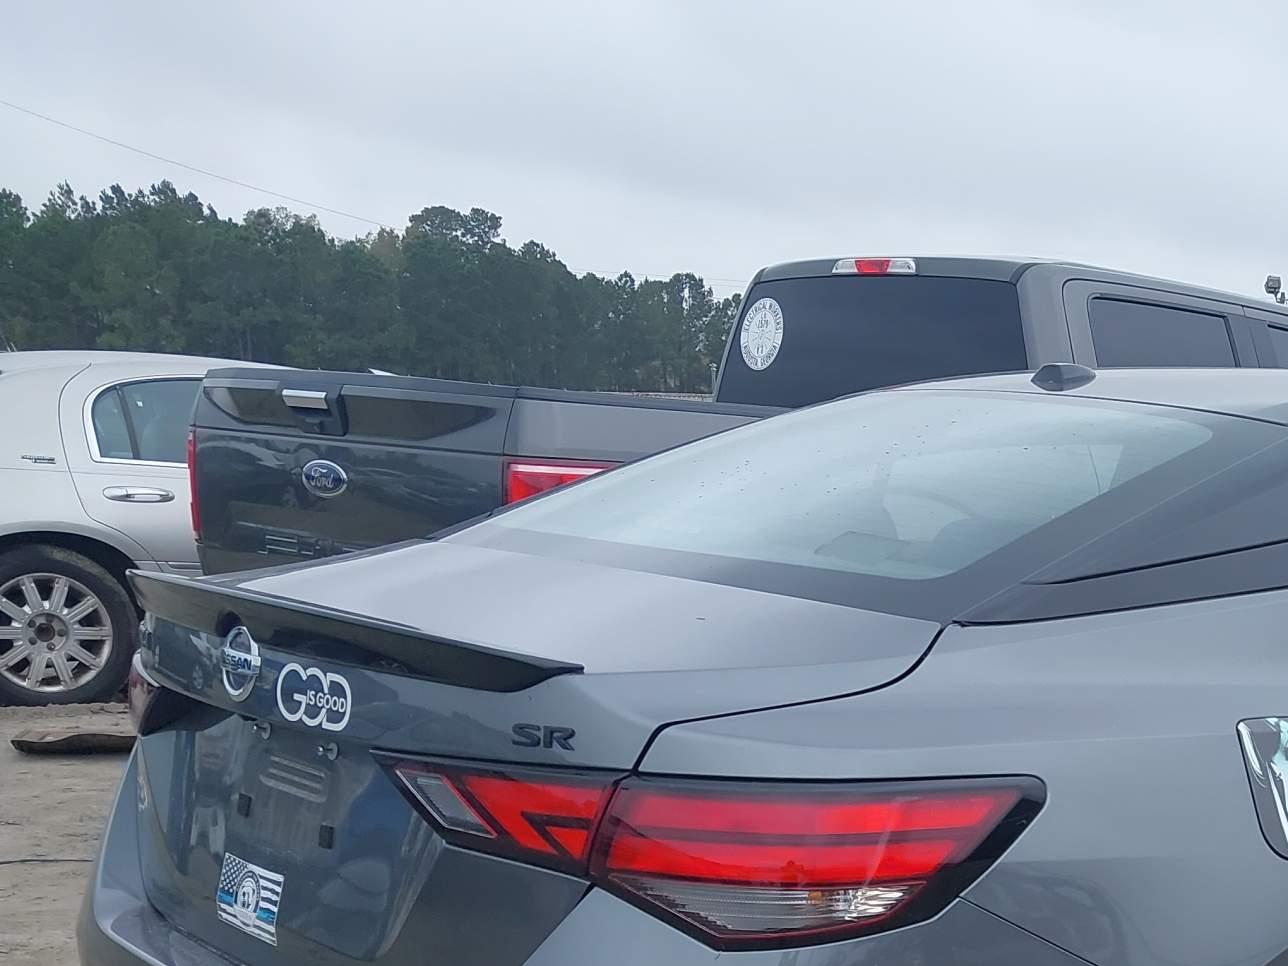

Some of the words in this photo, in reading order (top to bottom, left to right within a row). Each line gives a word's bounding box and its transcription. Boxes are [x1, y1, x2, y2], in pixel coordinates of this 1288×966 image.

[310, 466, 336, 489] Ford
[277, 663, 351, 731] GOD
[306, 689, 315, 705] IS
[316, 693, 346, 713] GOOD
[512, 723, 576, 751] SR
